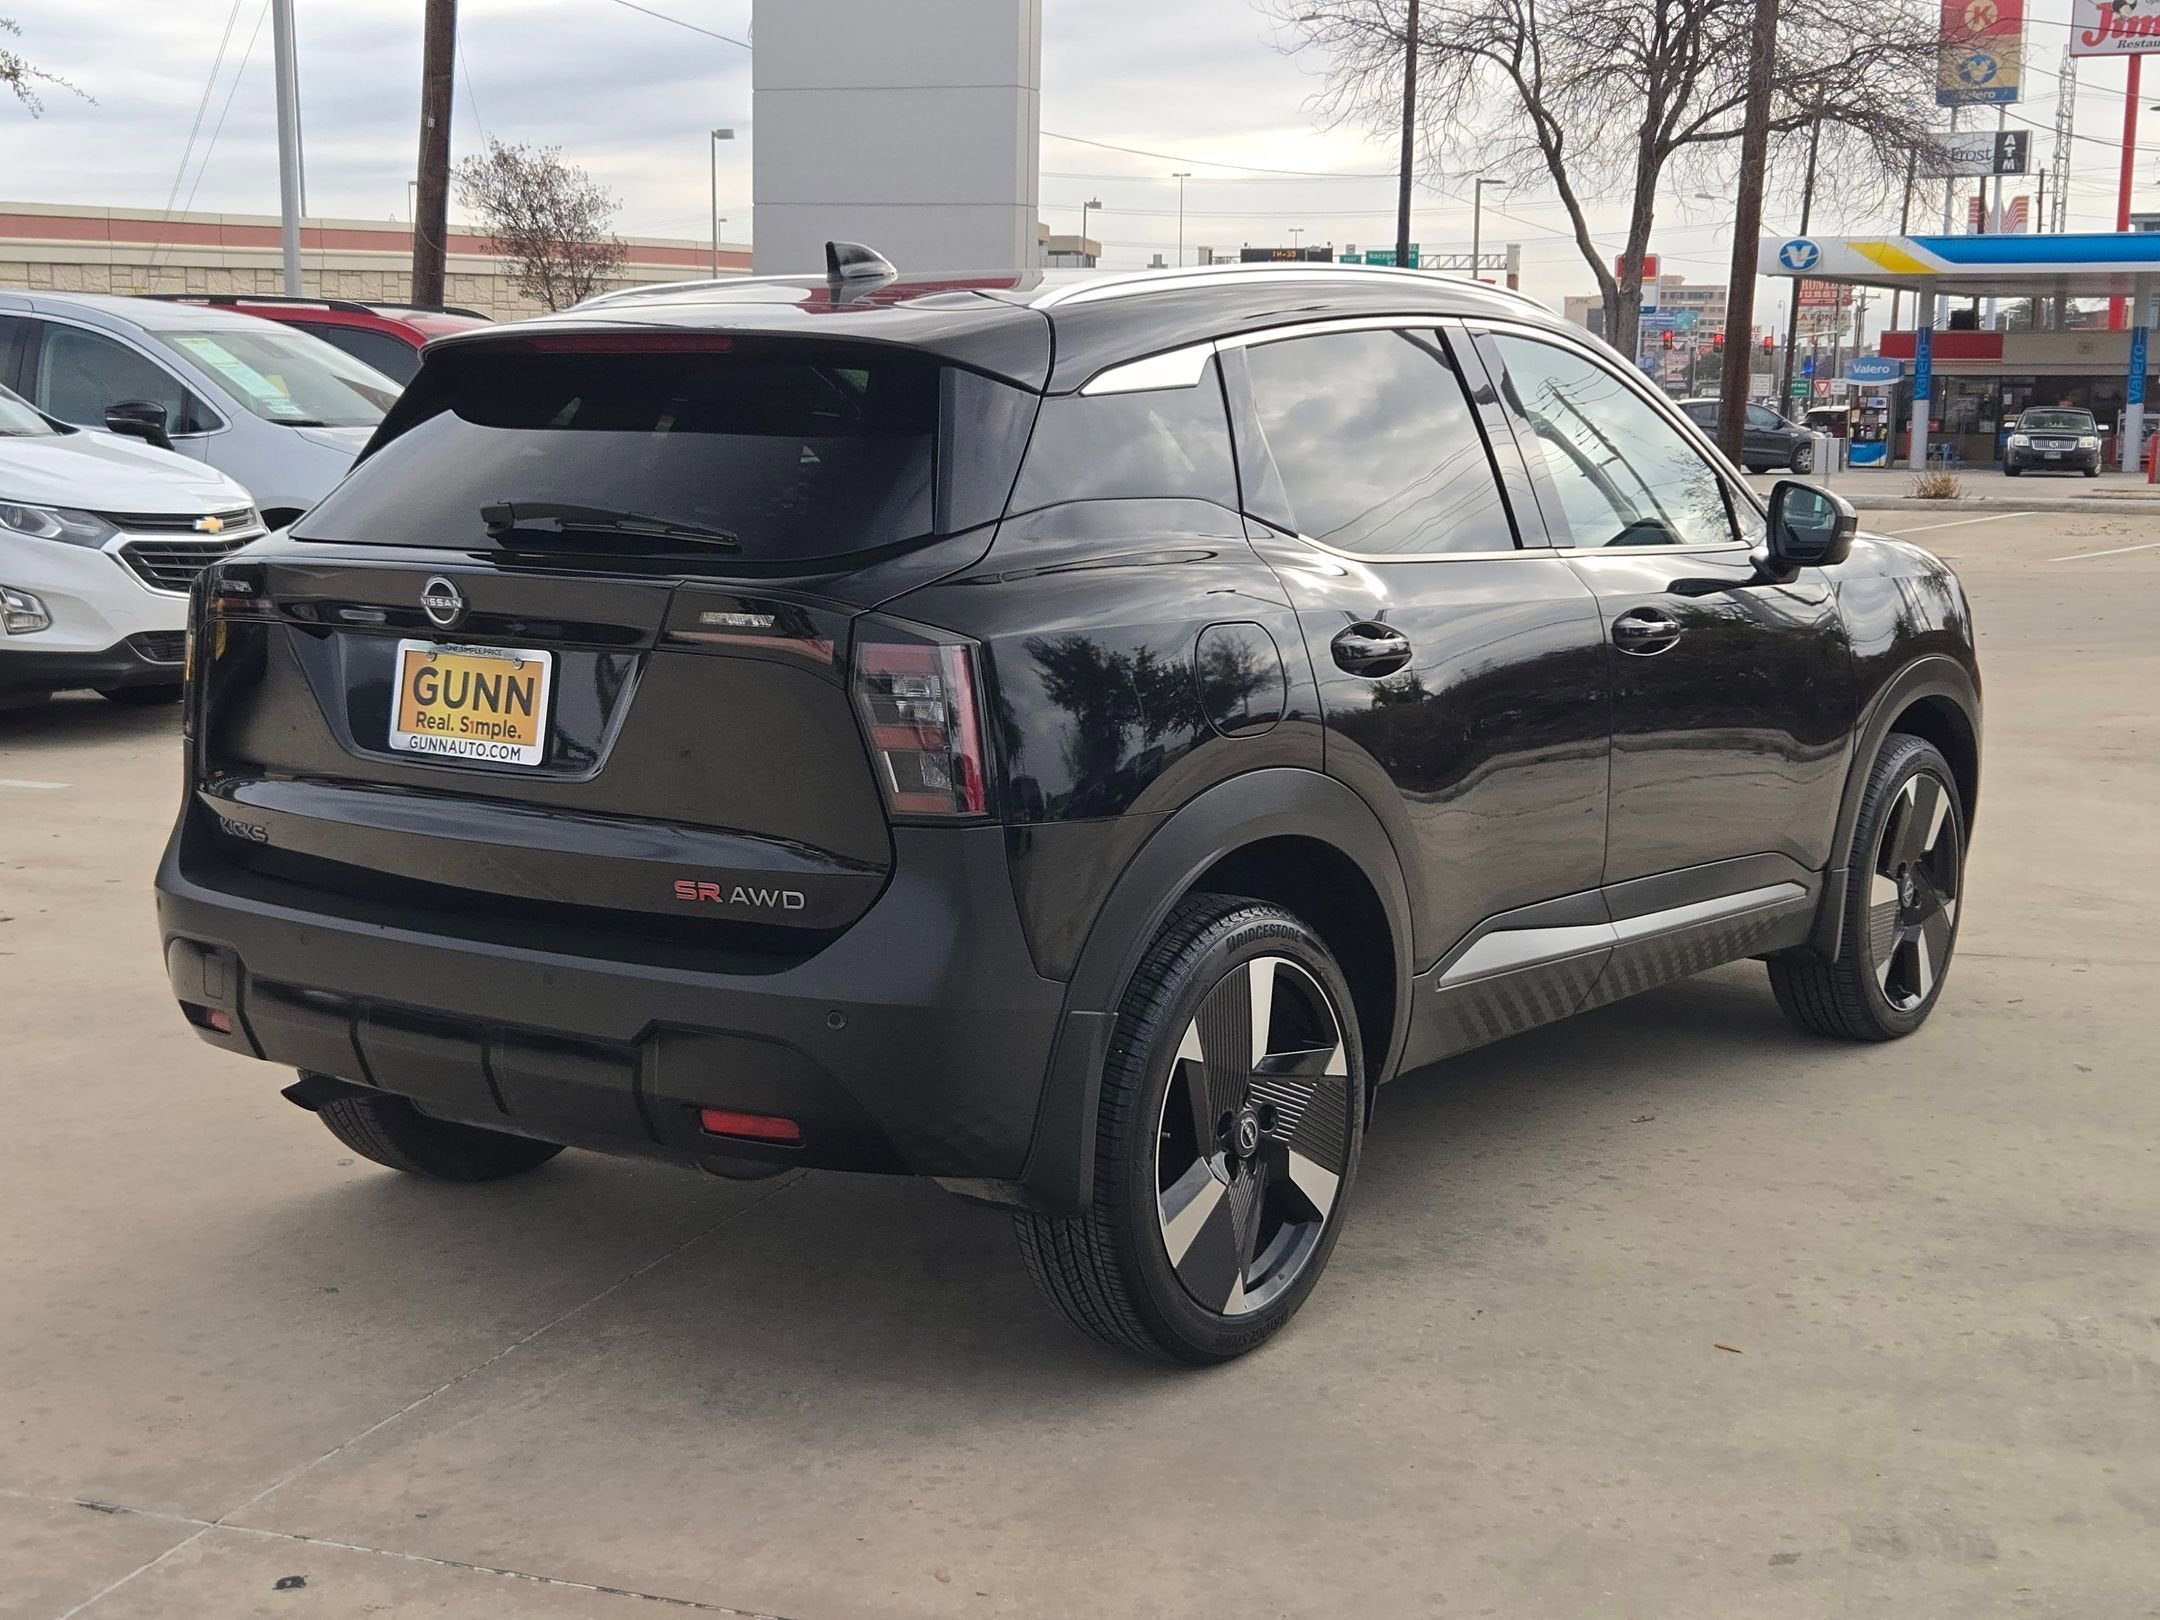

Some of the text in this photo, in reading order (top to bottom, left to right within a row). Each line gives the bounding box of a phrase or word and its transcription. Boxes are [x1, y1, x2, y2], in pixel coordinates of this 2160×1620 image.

[1951, 147, 1993, 161] Frost
[1853, 364, 1890, 374] Valero
[1914, 344, 1928, 399] Valero
[2128, 345, 2144, 402] Valero
[420, 596, 463, 608] NISSAN
[413, 667, 535, 717] GUNN
[416, 711, 455, 732] Real.
[410, 736, 521, 761] GUNNAUTO.COM
[219, 816, 269, 844] KICKS
[674, 880, 805, 910] SR AWD
[1226, 924, 1300, 954] BRIDGESTONE
